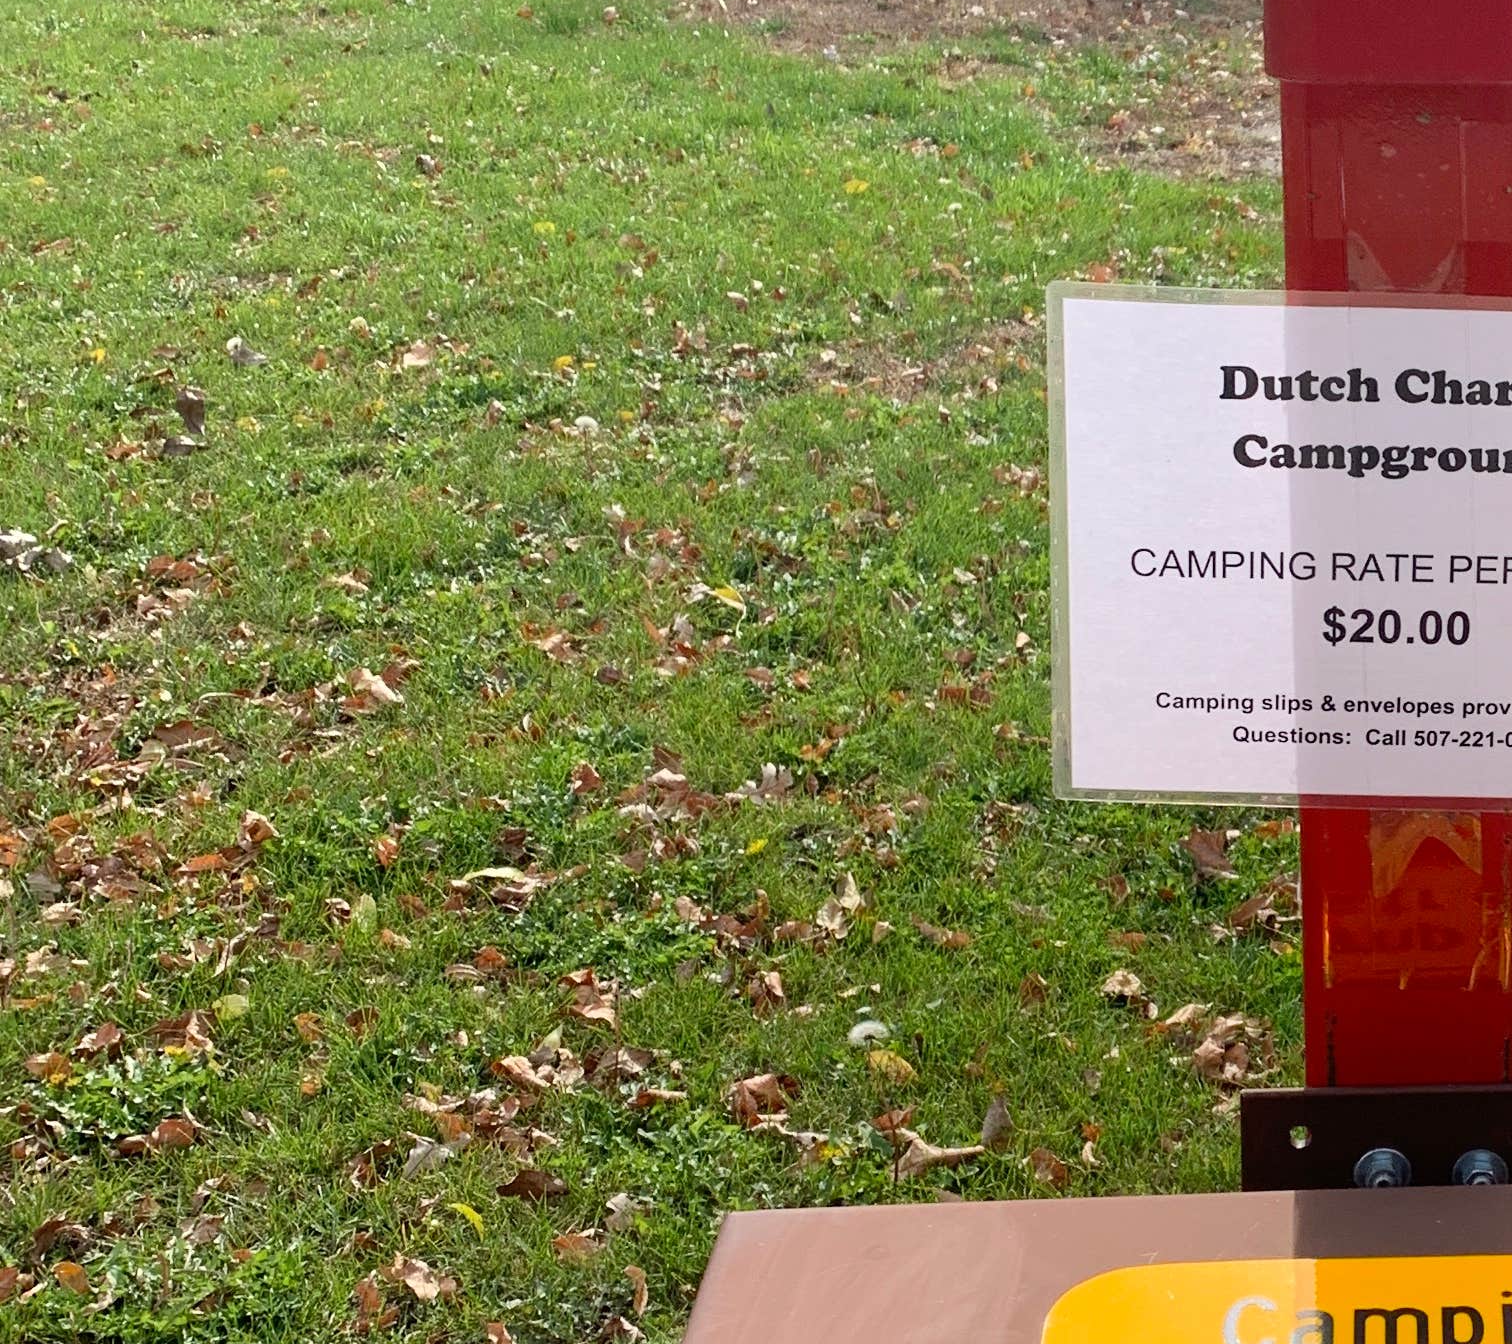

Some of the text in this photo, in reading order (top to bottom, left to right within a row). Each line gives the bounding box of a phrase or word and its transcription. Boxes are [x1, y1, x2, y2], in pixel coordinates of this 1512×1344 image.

[1219, 365, 1380, 403] Dutch
[1130, 547, 1317, 581] CAMPING
[1331, 553, 1435, 584] RATE
[1323, 607, 1471, 647] $20.00
[1155, 692, 1254, 714] Camping
[1261, 694, 1313, 714] slips
[1320, 695, 1336, 712] &
[1343, 697, 1455, 718] envelopes
[1232, 726, 1351, 746] Questions:
[1366, 728, 1407, 746] Call
